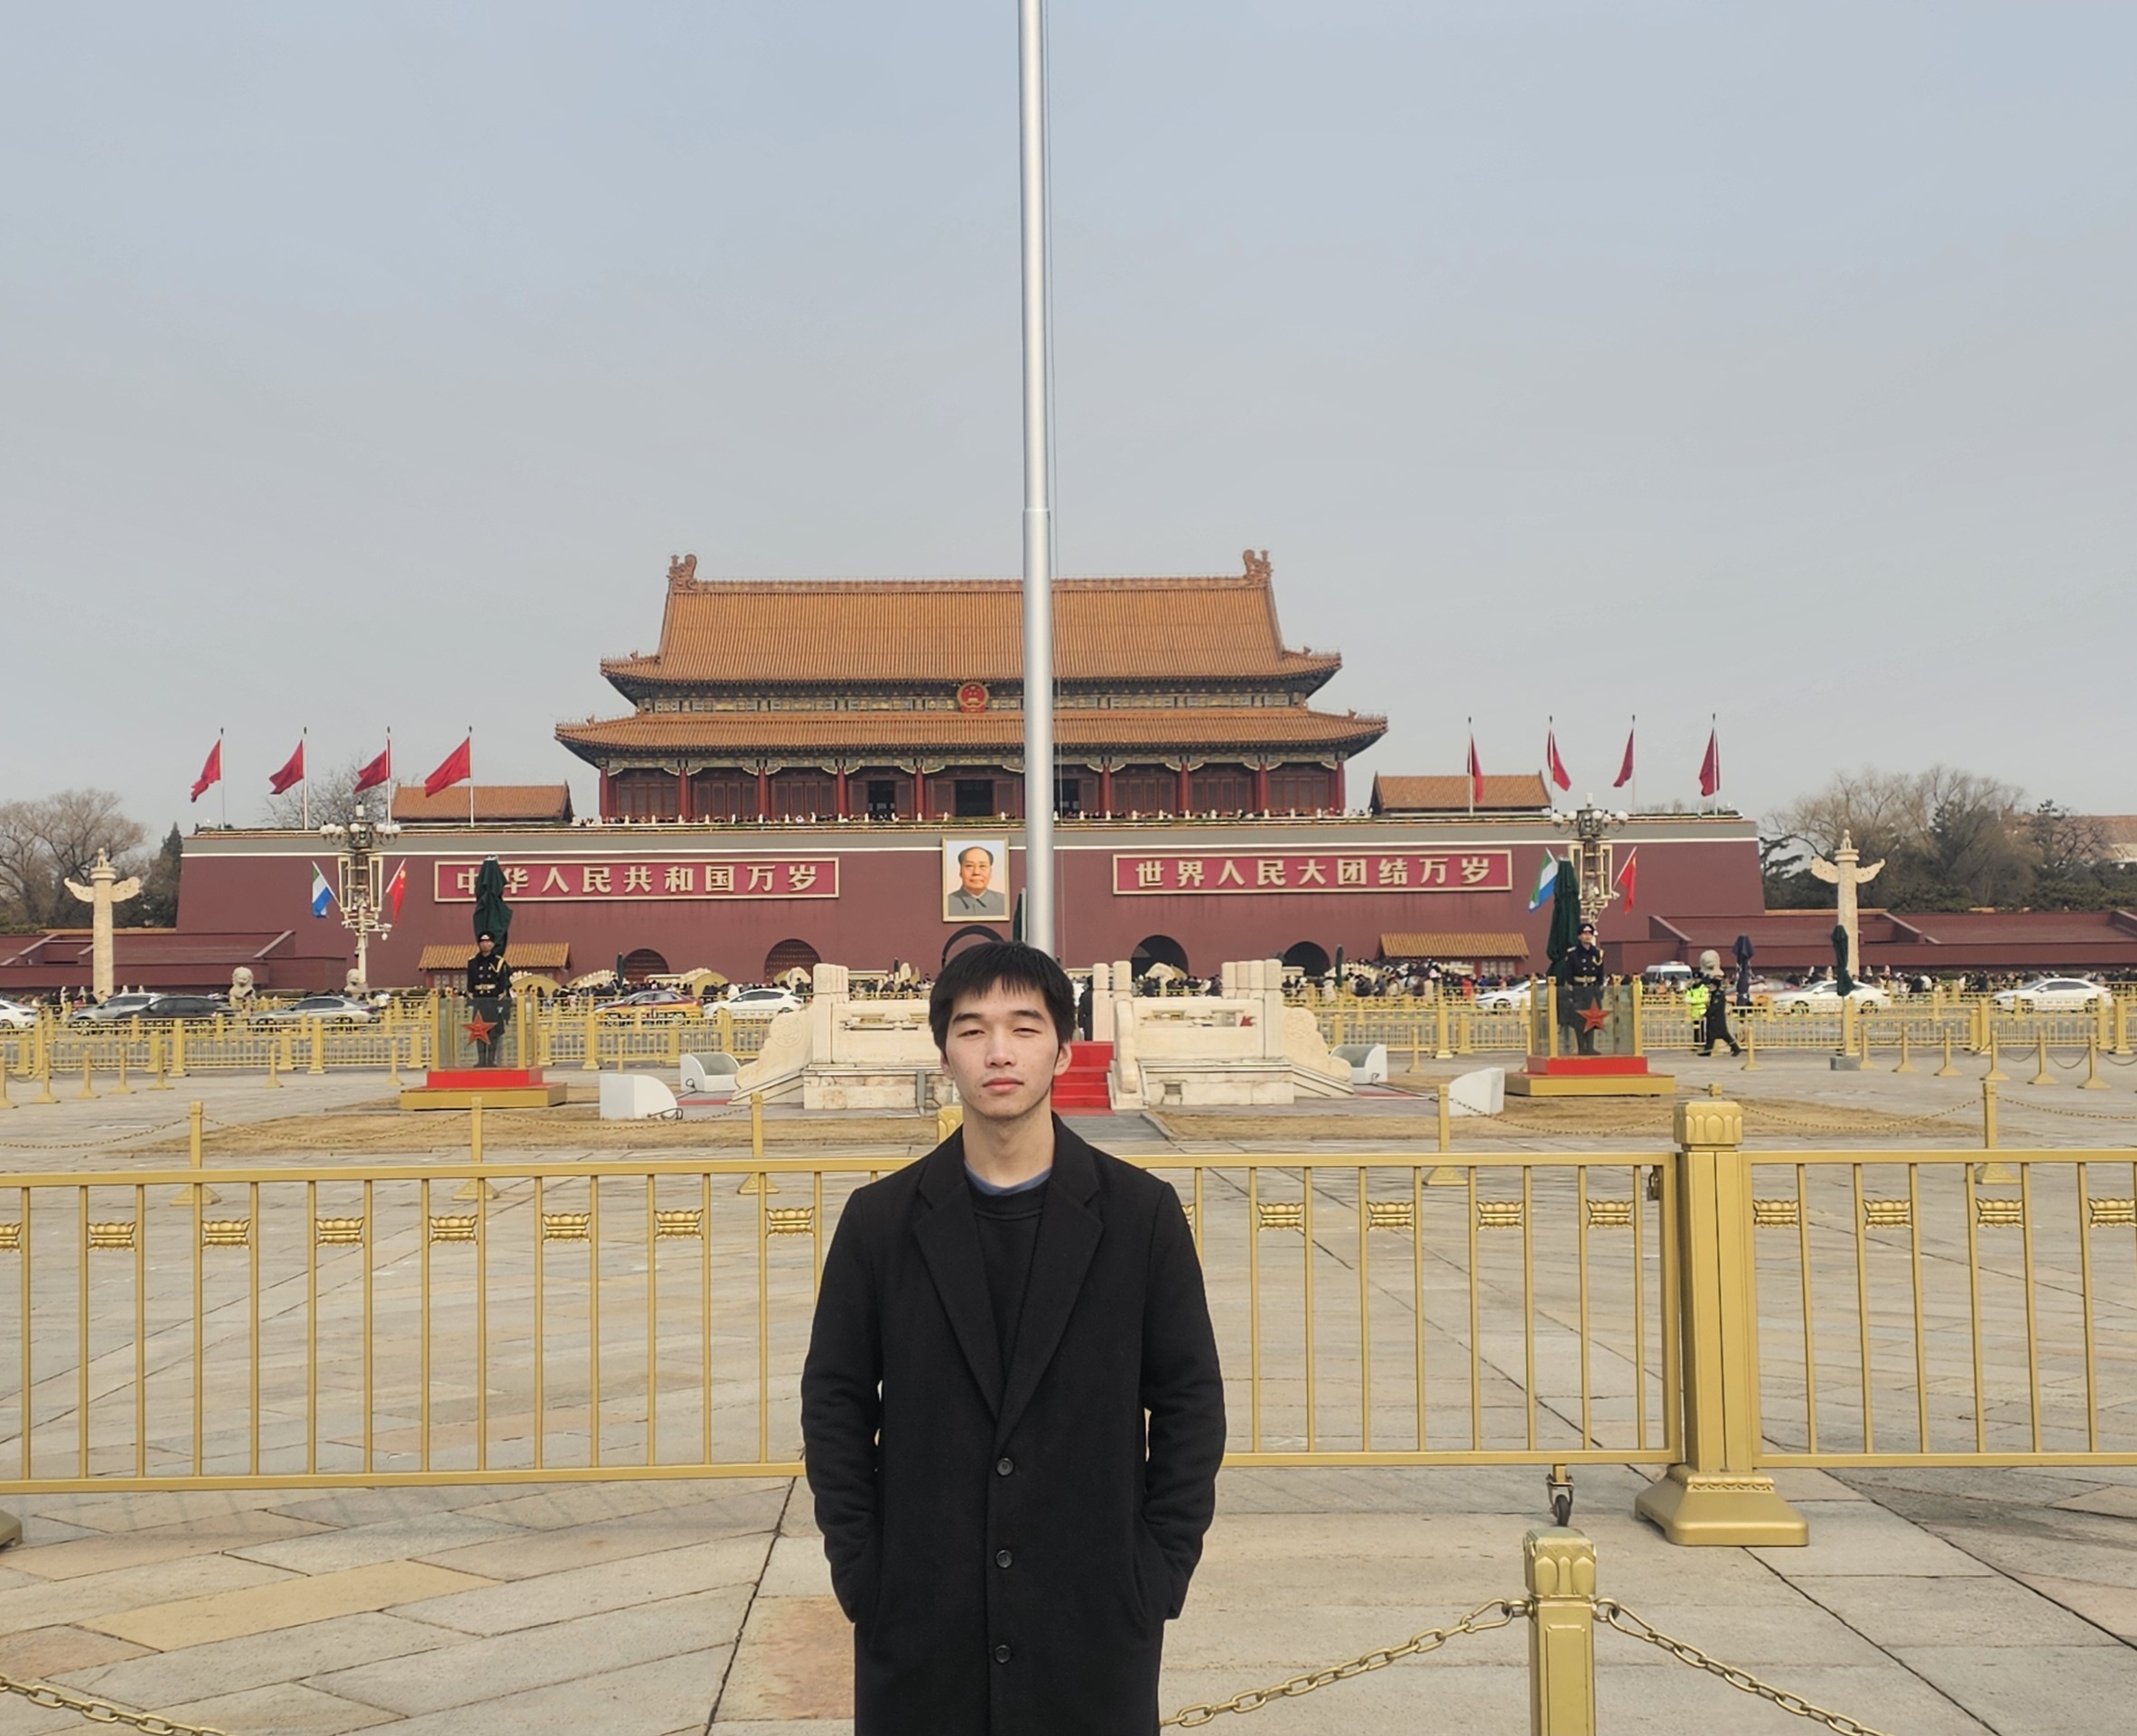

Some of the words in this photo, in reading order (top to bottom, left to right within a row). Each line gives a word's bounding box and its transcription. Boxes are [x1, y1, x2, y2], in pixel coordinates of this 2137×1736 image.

[457, 864, 817, 893] 中华人民共和国万岁
[1136, 856, 1490, 887] 世界人民大团结万岁
